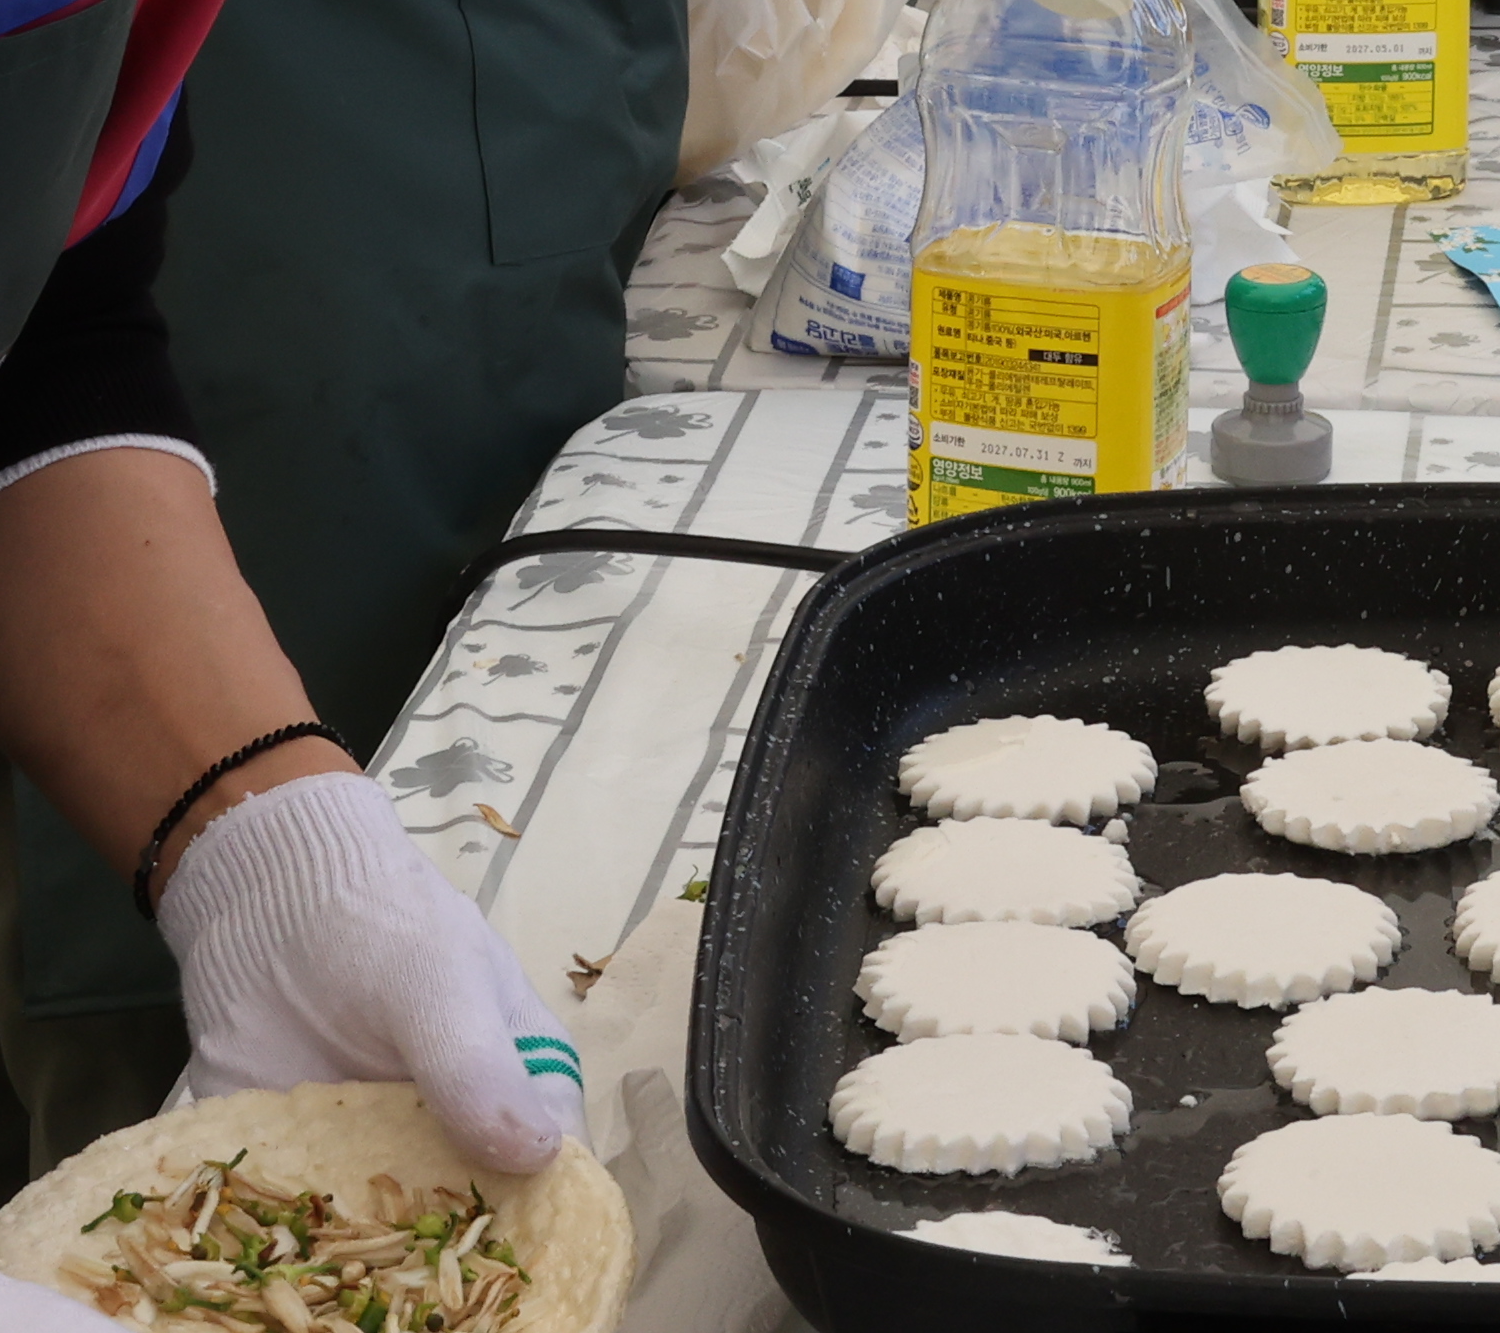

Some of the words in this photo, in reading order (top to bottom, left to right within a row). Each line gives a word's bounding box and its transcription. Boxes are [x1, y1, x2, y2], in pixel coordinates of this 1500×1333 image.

[1298, 43, 1328, 52] 소비기한
[1346, 44, 1404, 53] 2027.05.01
[933, 432, 965, 447] 소비기한
[981, 443, 1049, 461] 2027.07.31
[1073, 457, 1092, 469] 까지
[932, 458, 984, 481] 영양정보
